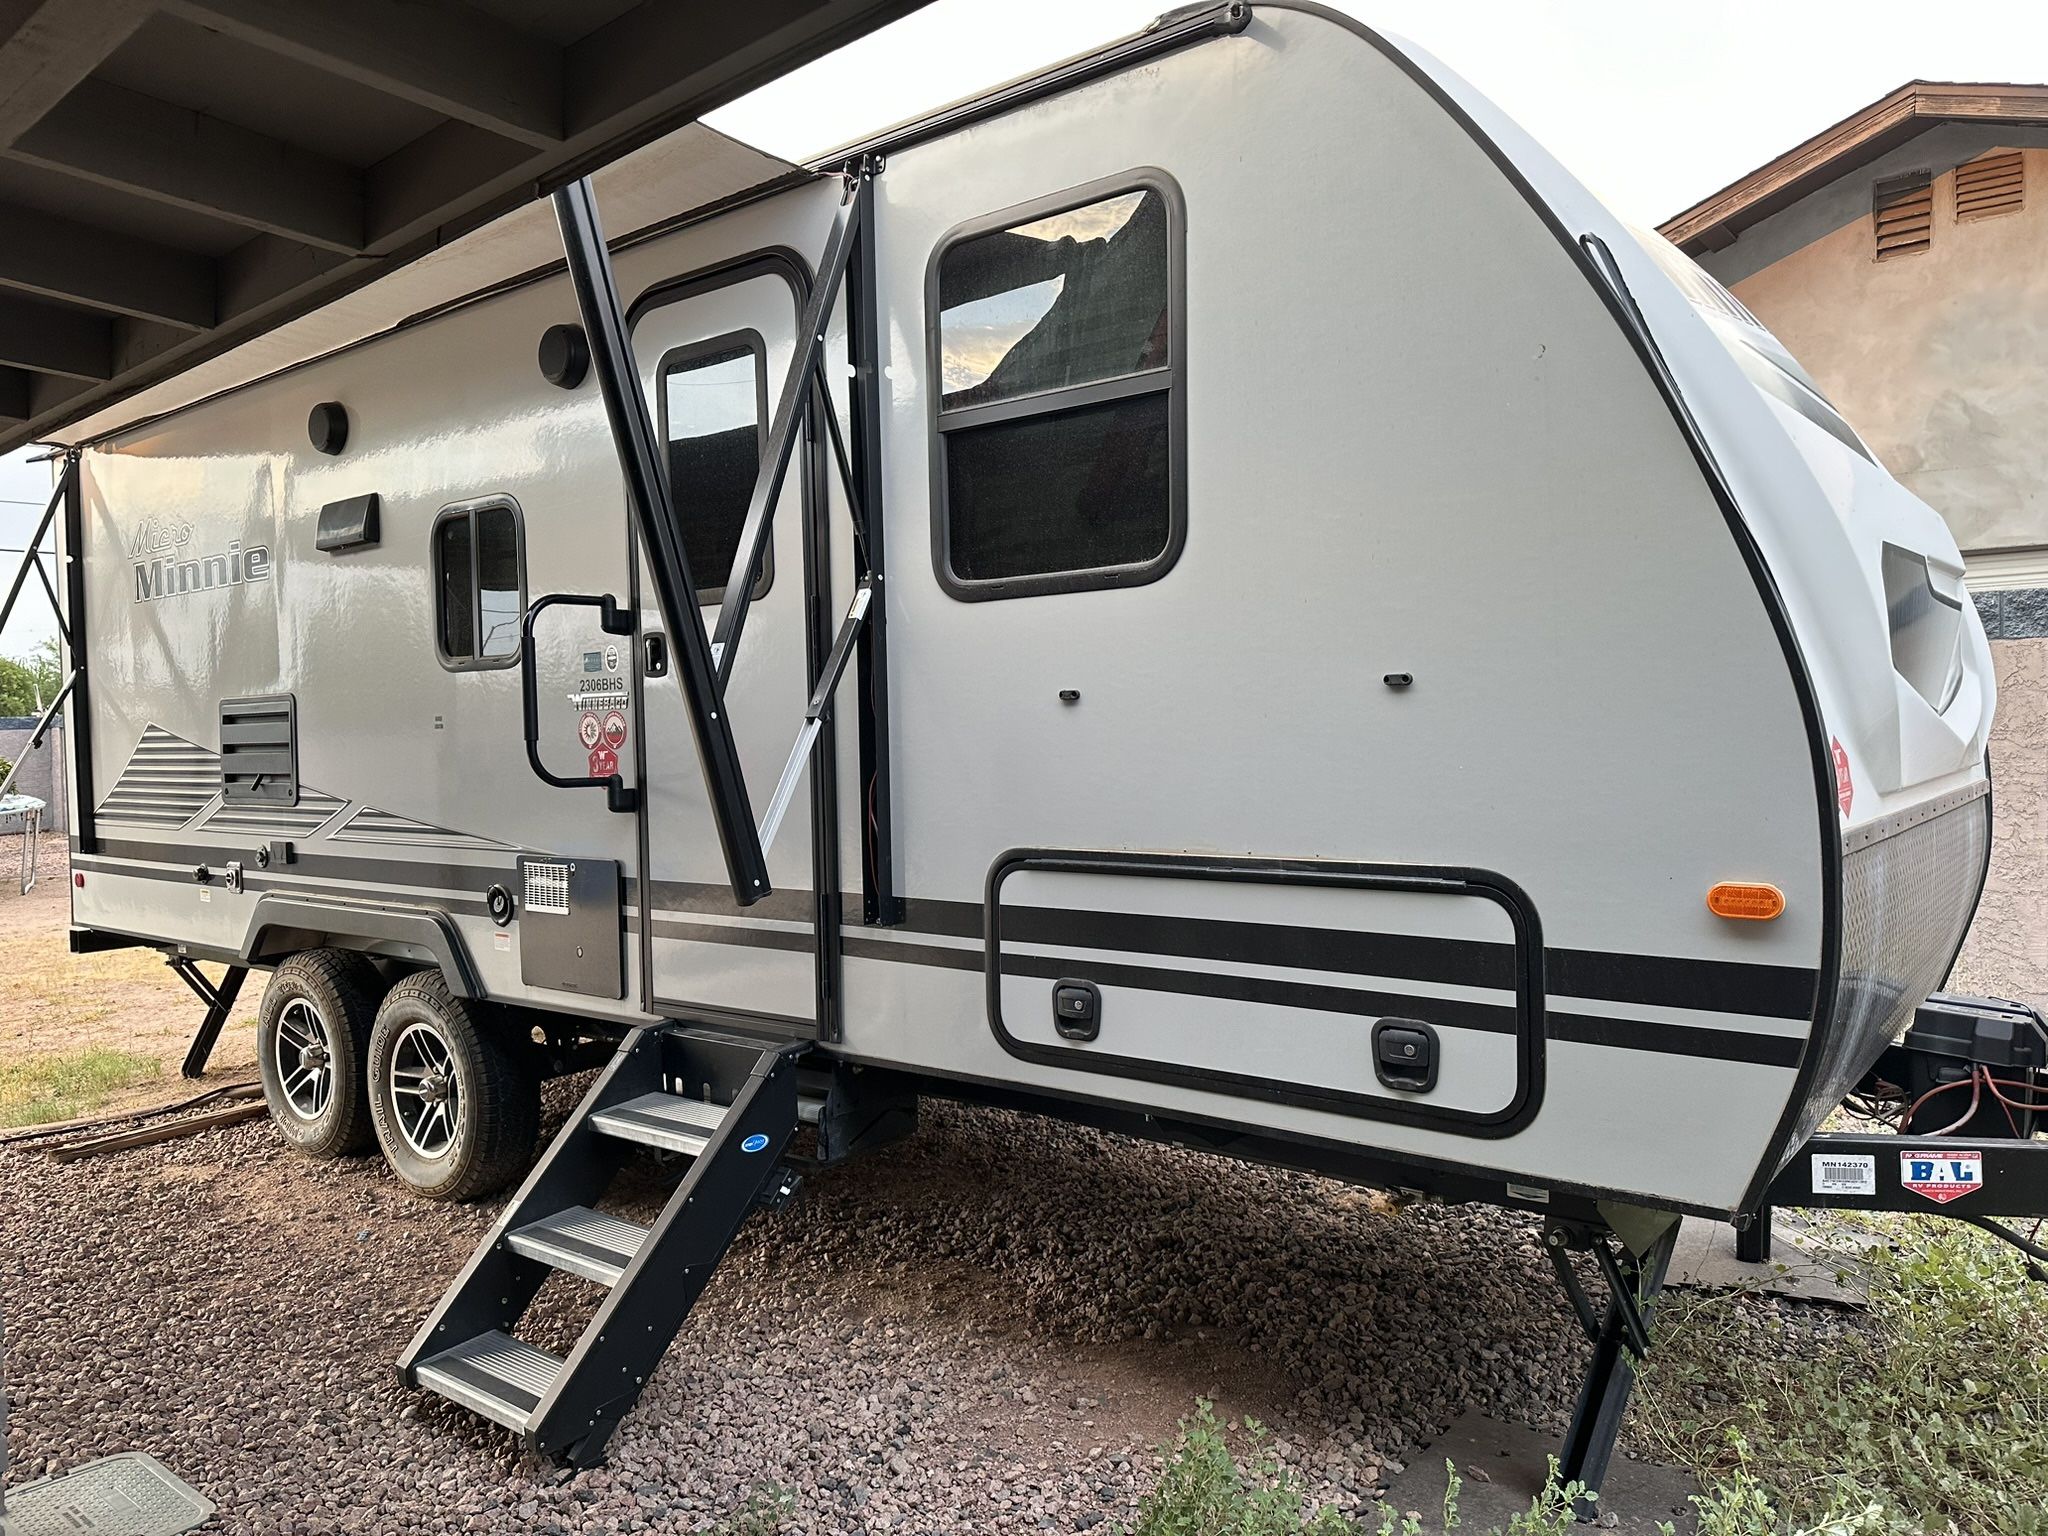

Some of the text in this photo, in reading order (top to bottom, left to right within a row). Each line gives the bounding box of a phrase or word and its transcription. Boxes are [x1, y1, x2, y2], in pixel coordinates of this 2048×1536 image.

[128, 517, 195, 559] Micro
[133, 539, 270, 603] Minnie
[580, 677, 623, 692] 2306BHS
[373, 1024, 399, 1158] TRAIL GUIDE
[1822, 1161, 1869, 1169] MN142370
[1910, 1161, 1973, 1182] BAL
